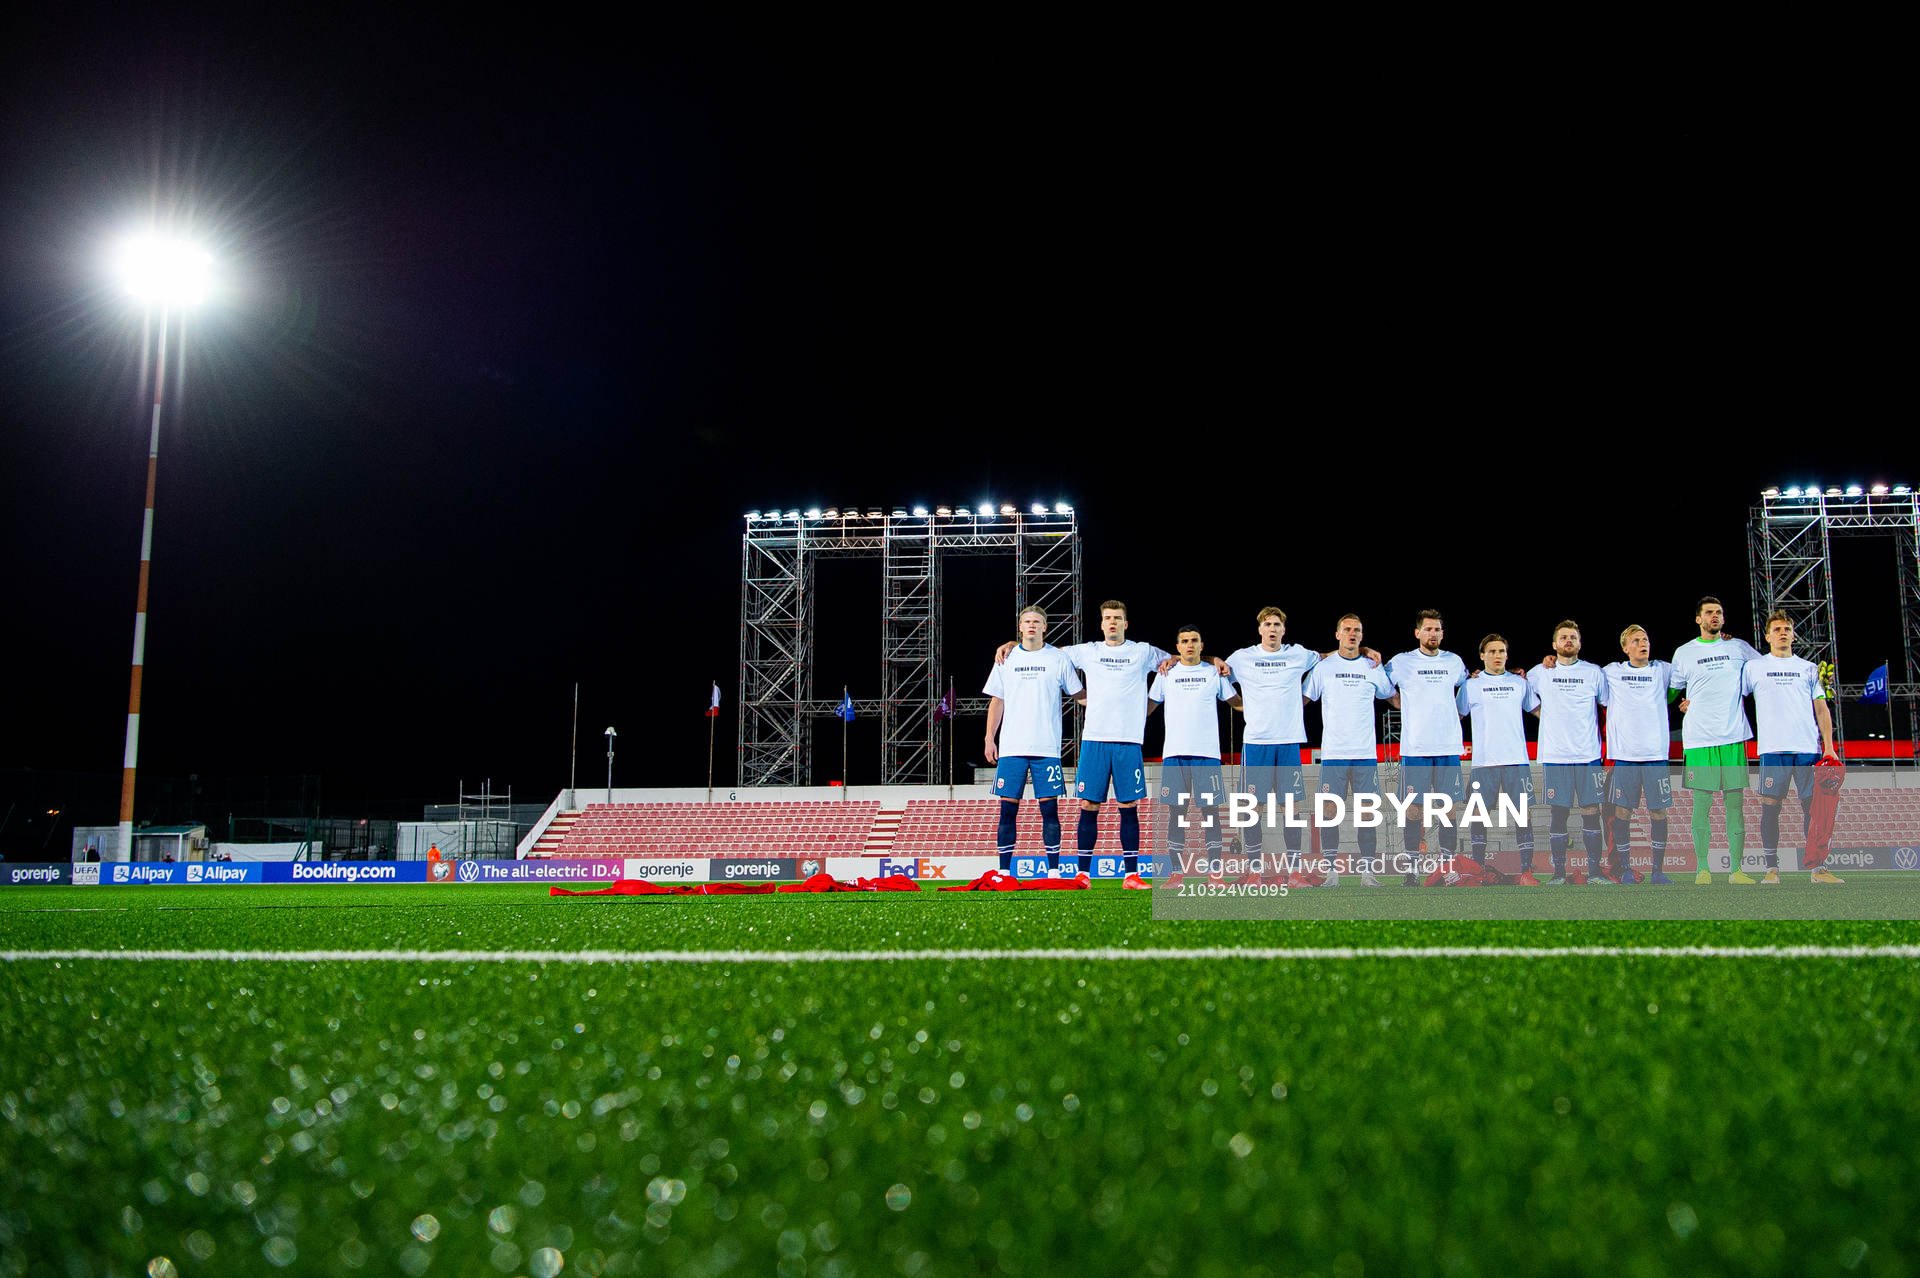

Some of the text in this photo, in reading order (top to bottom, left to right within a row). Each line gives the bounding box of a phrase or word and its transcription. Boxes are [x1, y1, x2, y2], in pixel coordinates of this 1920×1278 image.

[1697, 657, 1713, 665] HUMAN
[1046, 765, 1062, 782] 23
[1134, 768, 1142, 785] 9
[1210, 774, 1220, 791] 11
[1521, 777, 1534, 793] 16
[1658, 778, 1670, 795] 15
[729, 792, 737, 801] G
[1036, 860, 1079, 875] Apay
[1117, 859, 1164, 875] Apay
[1823, 851, 1874, 868] orenje
[12, 866, 60, 883] gorenje
[74, 866, 98, 874] UEFA
[131, 866, 173, 882] Alipay
[204, 865, 248, 881] Alipay
[292, 863, 396, 882] Booking.com
[483, 864, 621, 878] The all-electric ID.4
[640, 862, 694, 878] gorenje
[725, 861, 780, 878] gorenje
[879, 858, 947, 879] FedEx
